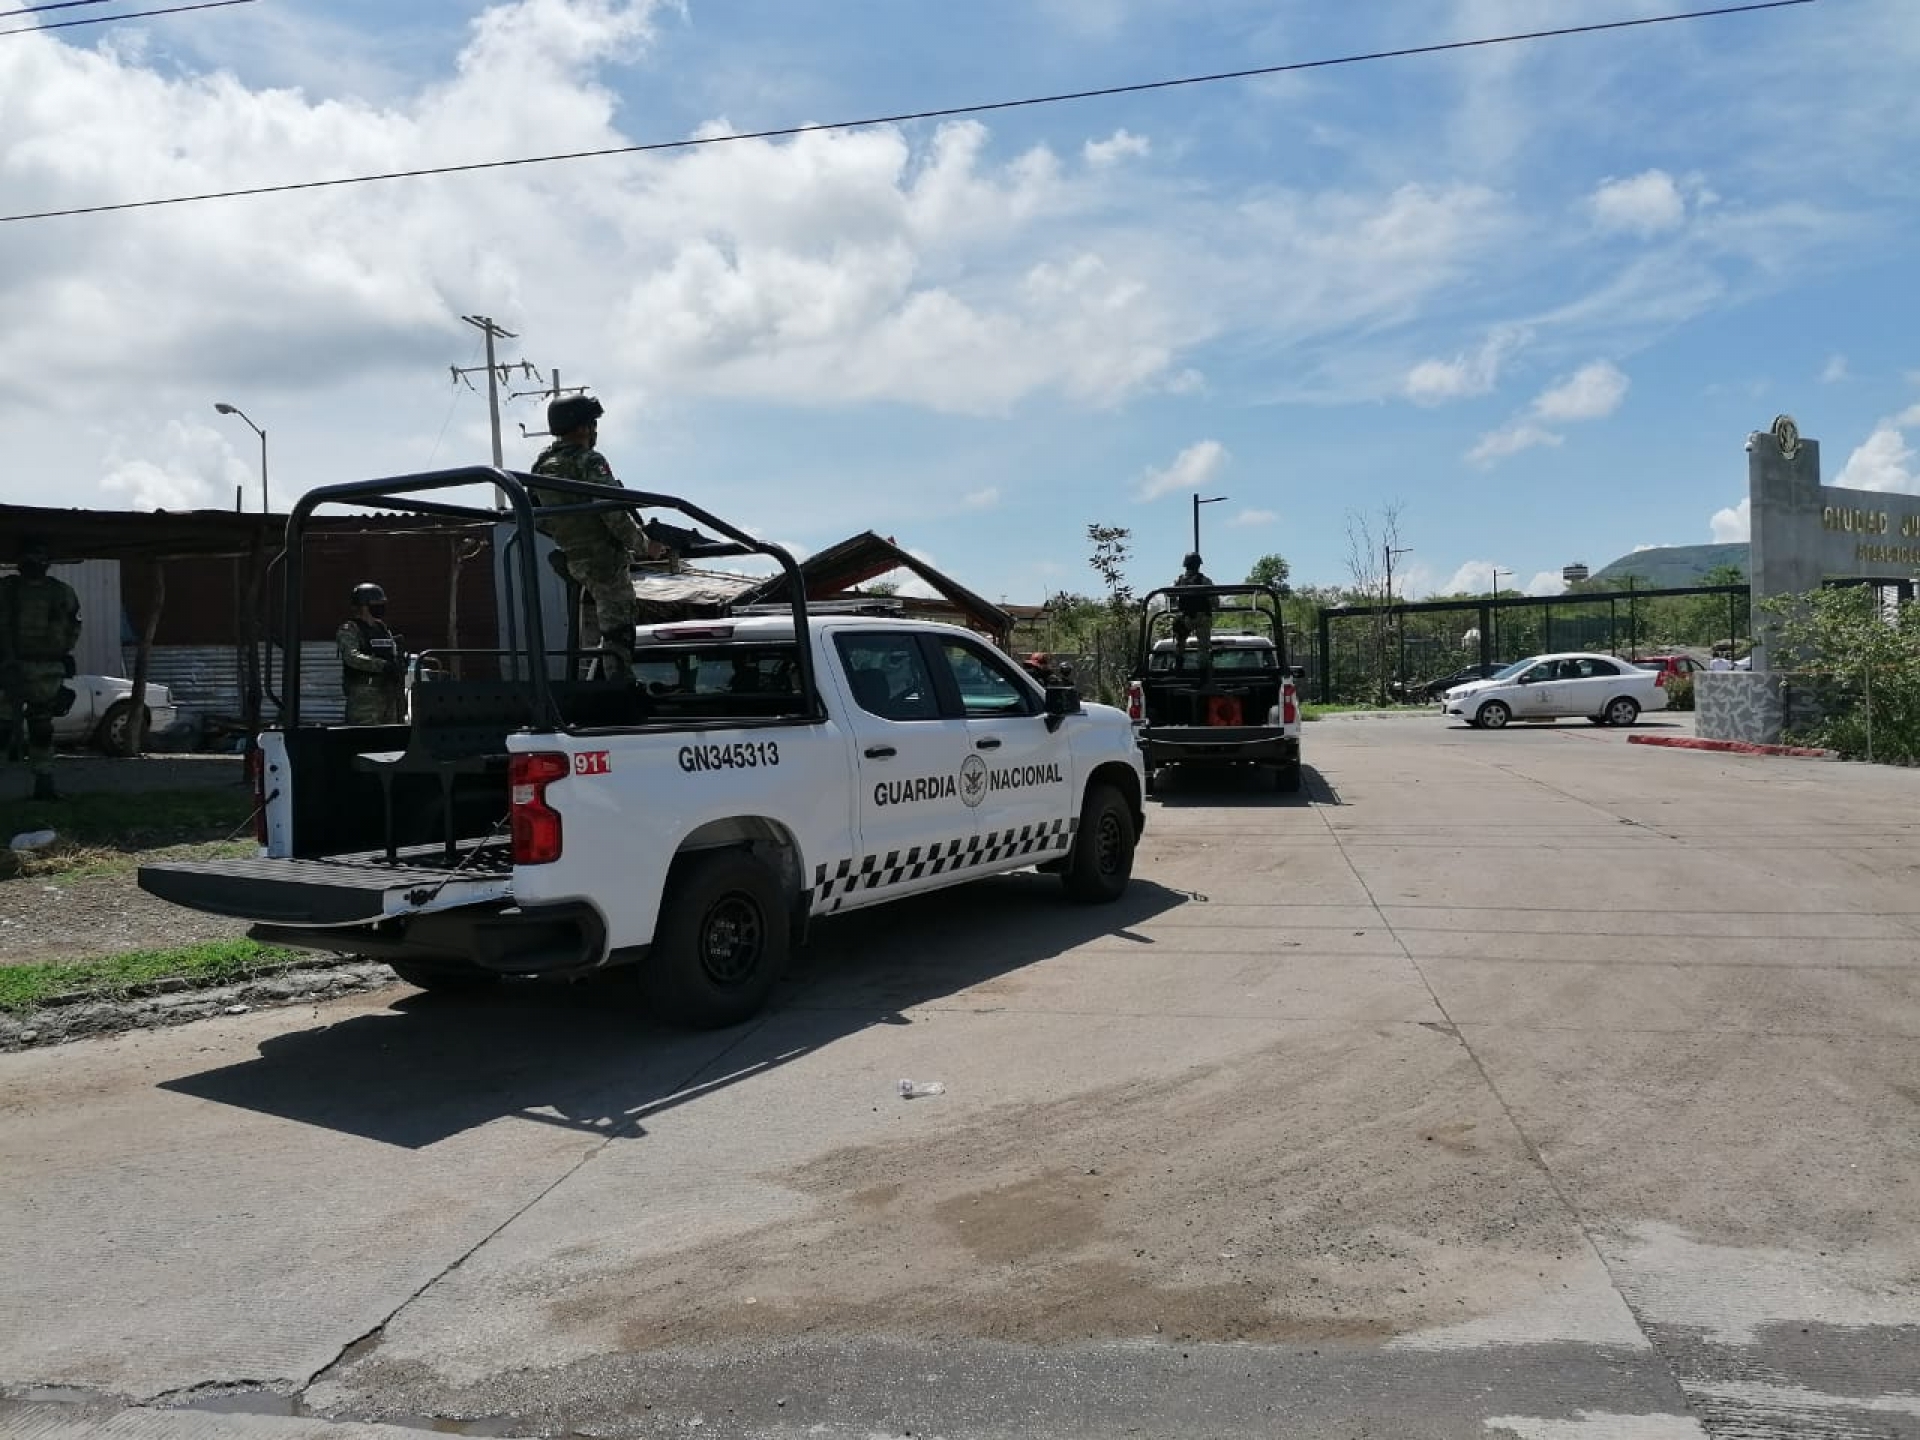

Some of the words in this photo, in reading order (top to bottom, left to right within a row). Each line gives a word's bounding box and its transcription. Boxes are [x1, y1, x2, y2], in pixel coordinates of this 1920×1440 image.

[1823, 506, 1888, 535] CIUDAD
[575, 753, 611, 774] 911
[678, 741, 779, 772] GN345313
[874, 775, 956, 806] GUARDIA
[990, 763, 1062, 791] NACIONAL
